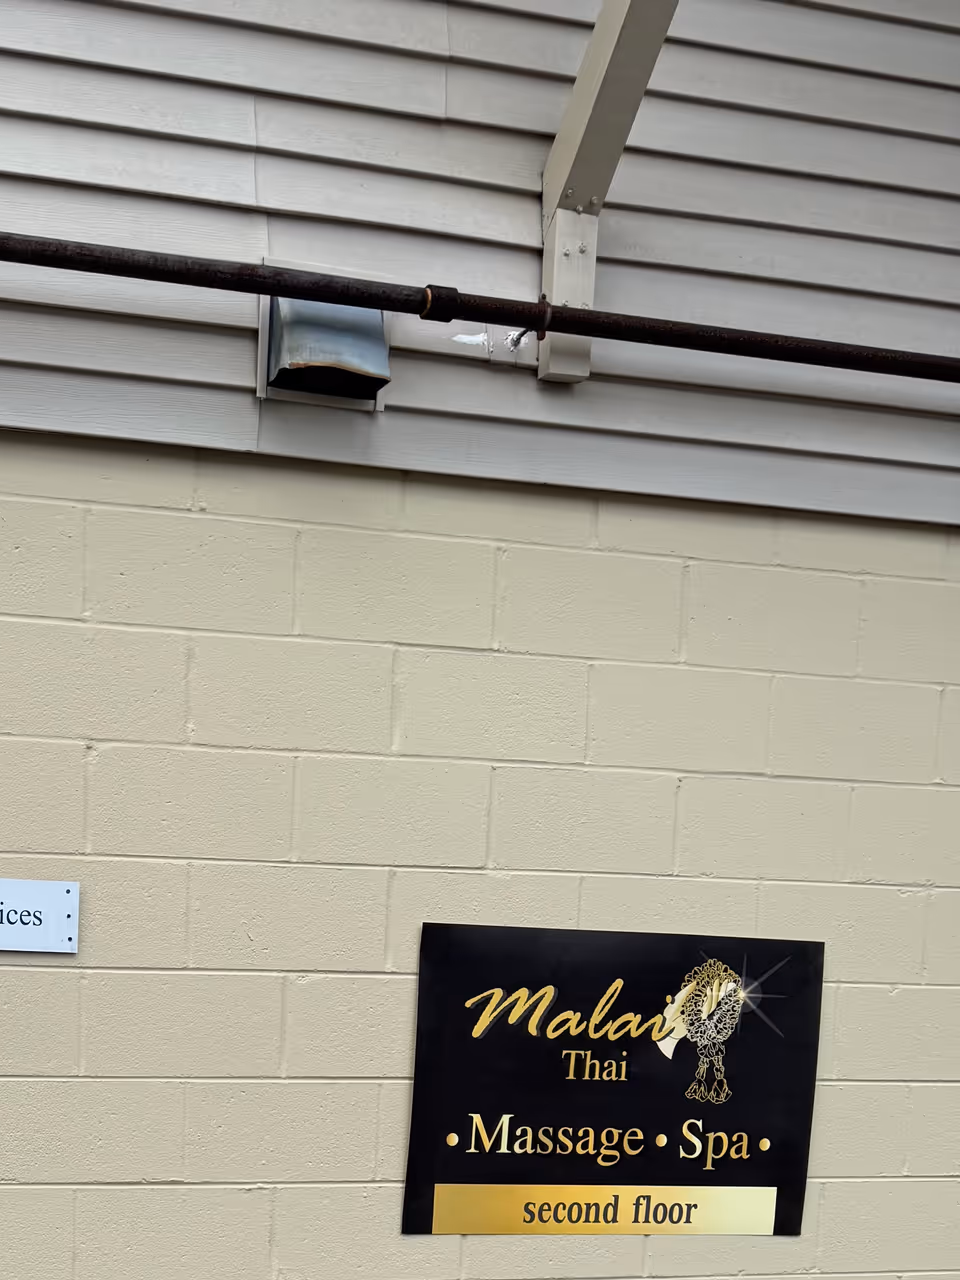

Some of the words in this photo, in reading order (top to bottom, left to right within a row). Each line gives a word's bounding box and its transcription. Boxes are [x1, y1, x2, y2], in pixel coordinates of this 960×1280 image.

[562, 1050, 628, 1081] Thai
[465, 1113, 644, 1167] Massage
[679, 1118, 750, 1171] Spa
[522, 1195, 620, 1224] second
[631, 1195, 698, 1224] floor
